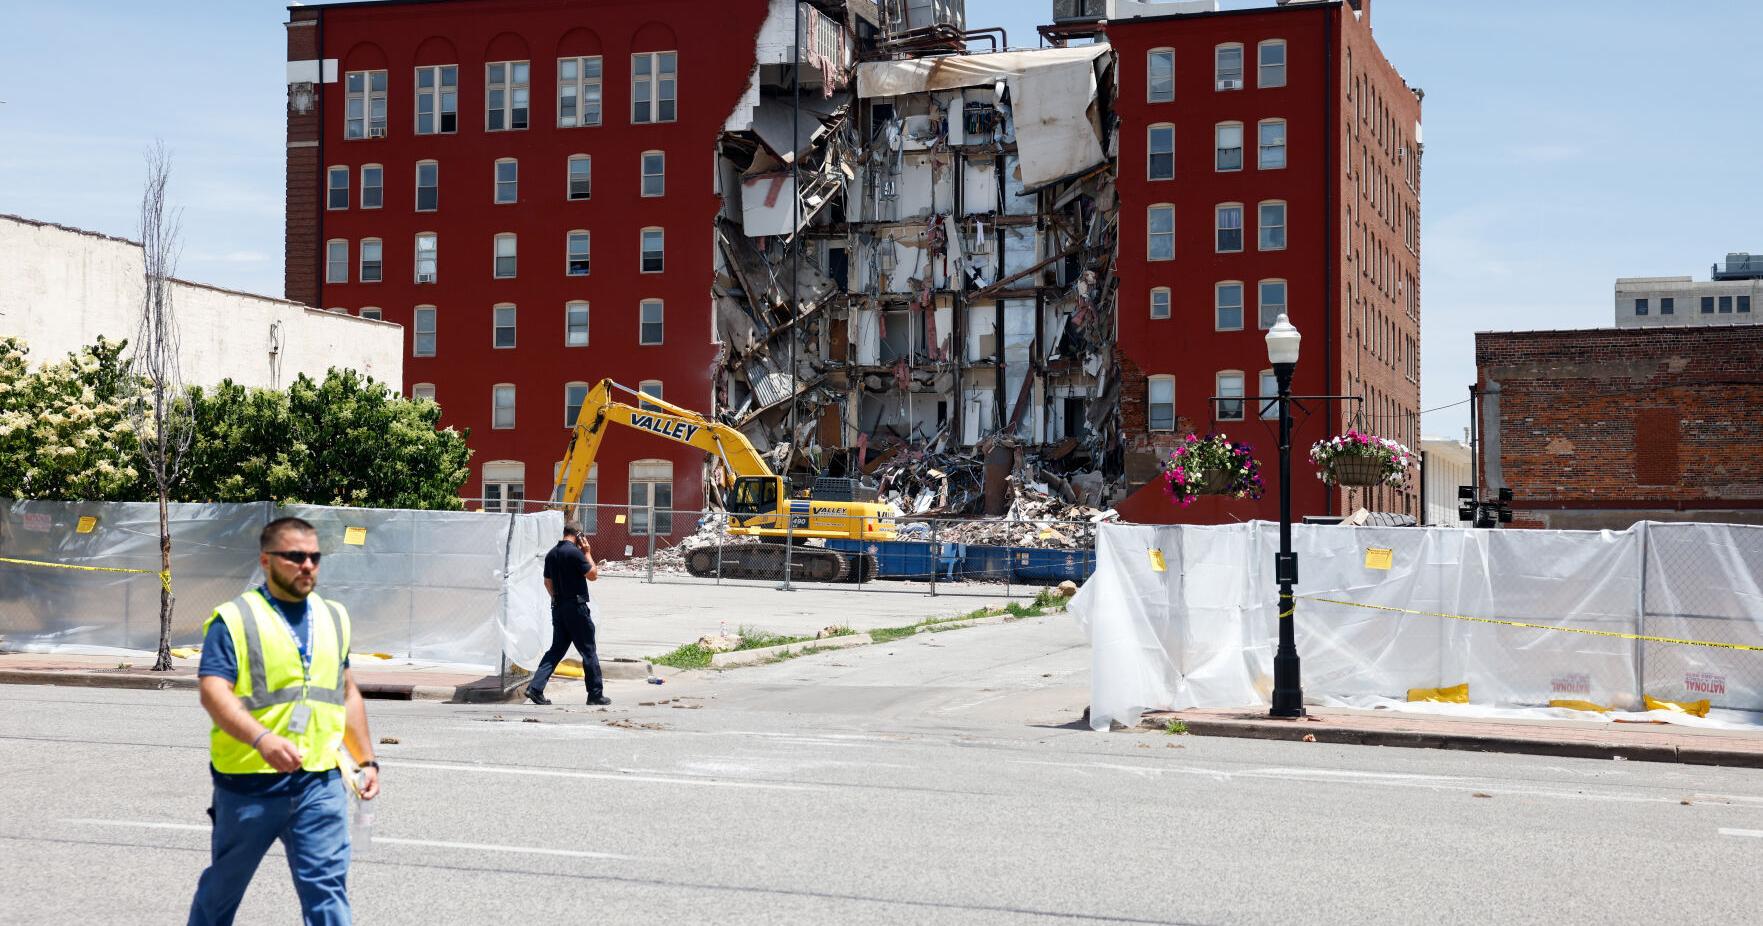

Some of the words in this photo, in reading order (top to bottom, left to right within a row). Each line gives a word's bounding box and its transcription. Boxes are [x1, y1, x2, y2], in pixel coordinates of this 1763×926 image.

[631, 413, 700, 442] VALLEY
[813, 506, 847, 515] VALLEY
[1684, 680, 1725, 695] NATIONAL
